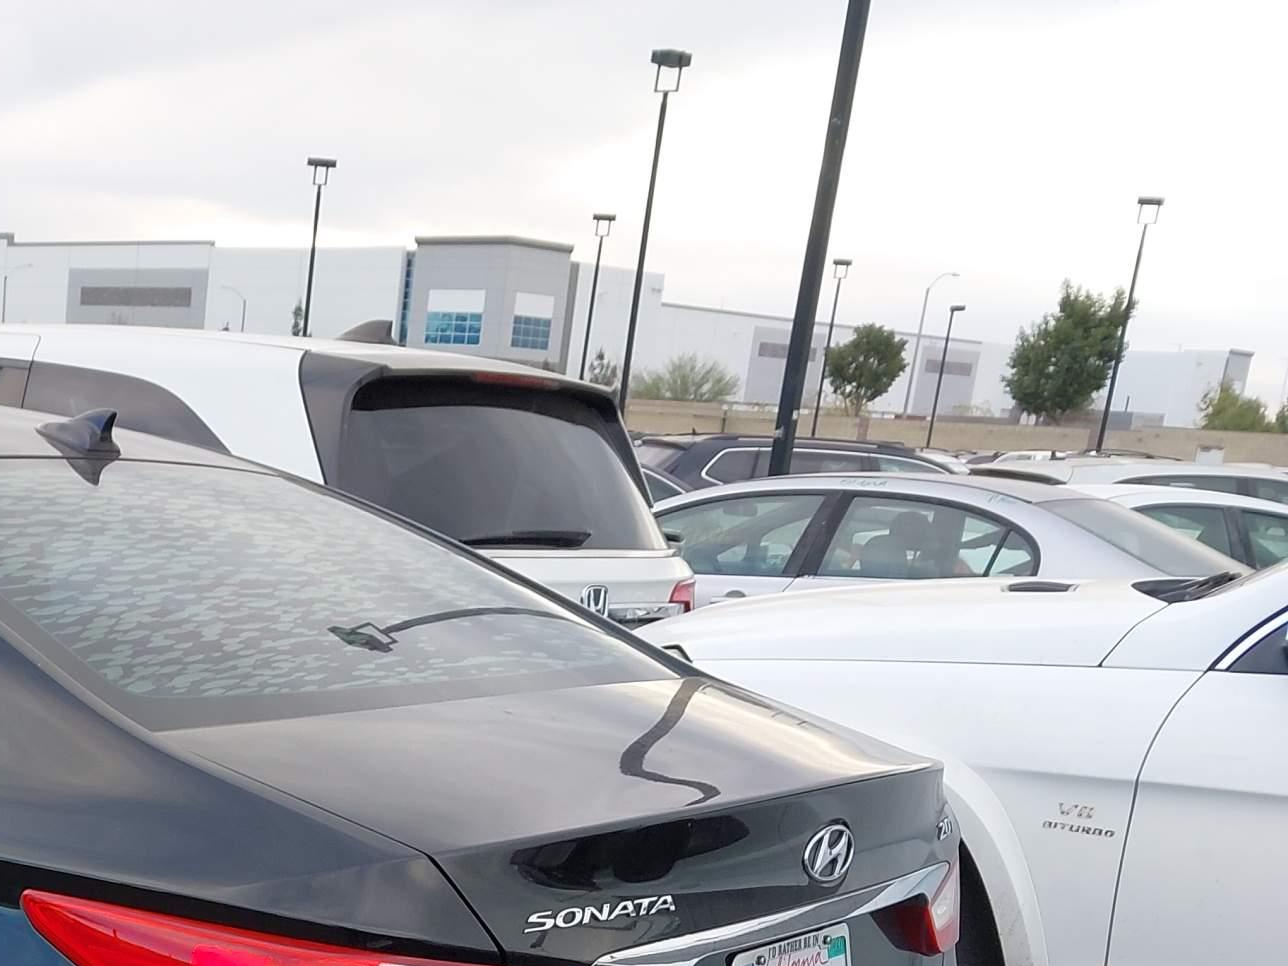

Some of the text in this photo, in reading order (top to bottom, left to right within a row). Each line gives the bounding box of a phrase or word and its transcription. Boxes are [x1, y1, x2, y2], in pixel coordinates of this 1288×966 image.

[524, 894, 676, 934] SONATA
[778, 938, 802, 956] RATHER
[804, 936, 811, 949] BE
[813, 934, 819, 946] IN
